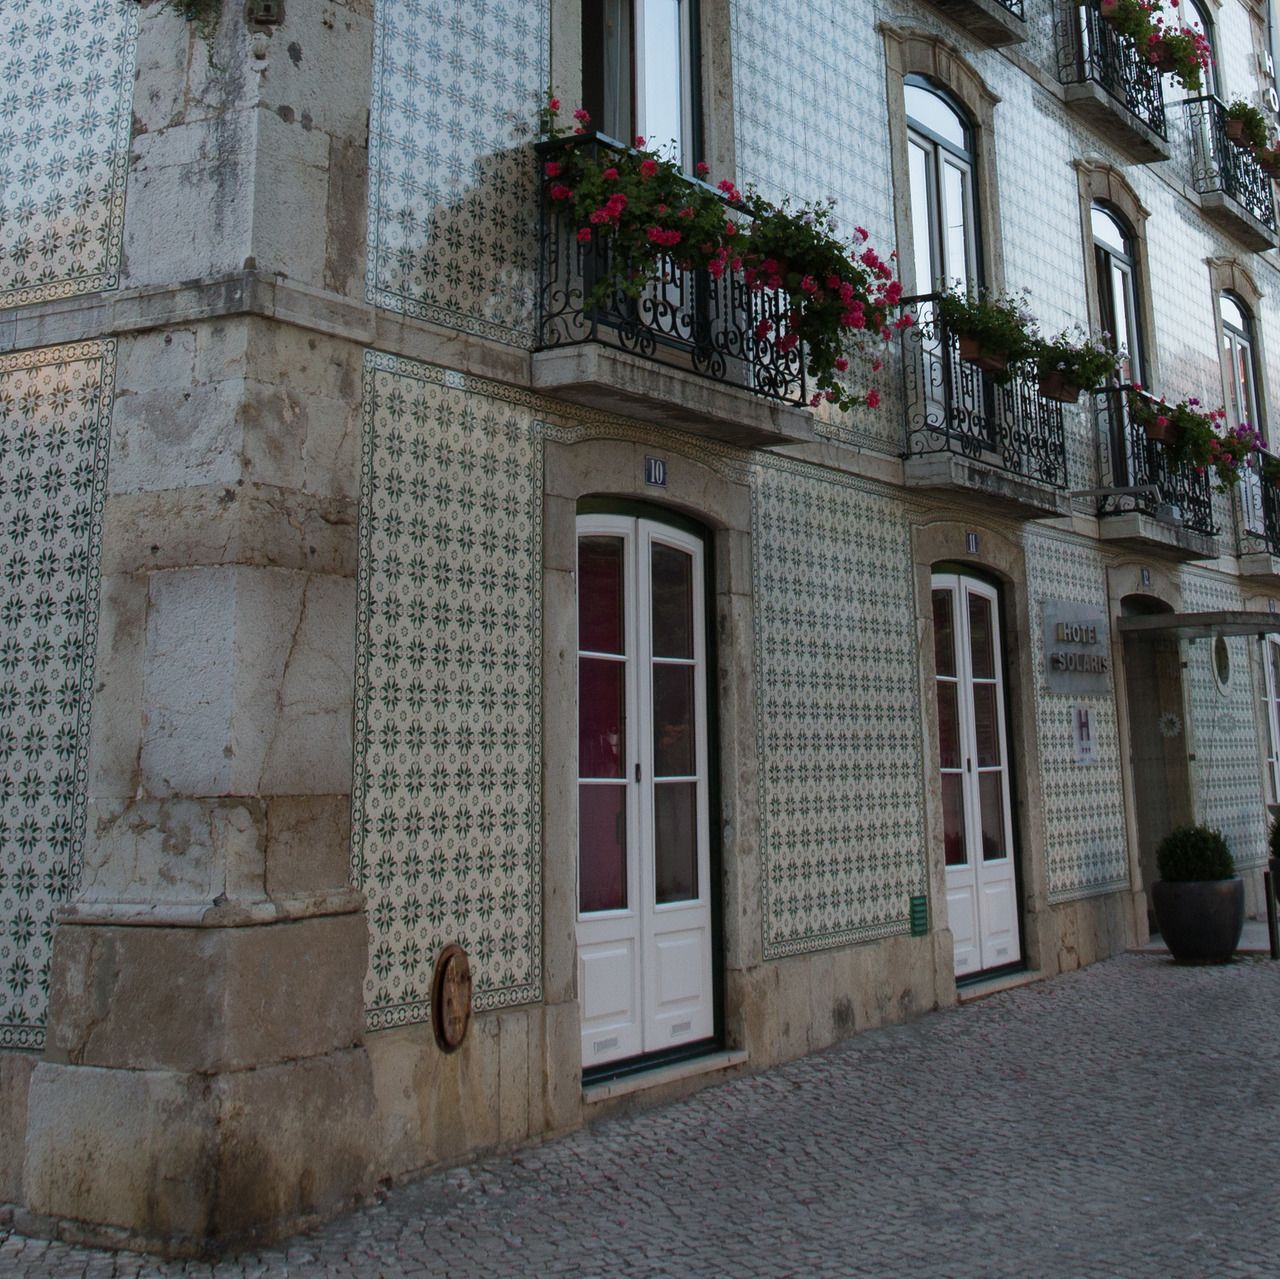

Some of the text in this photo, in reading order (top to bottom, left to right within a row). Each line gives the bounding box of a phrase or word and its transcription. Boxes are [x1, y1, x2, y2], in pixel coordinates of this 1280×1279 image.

[651, 459, 663, 484] 10
[1059, 651, 1108, 673] SOLARIS
[1077, 710, 1090, 741] H
